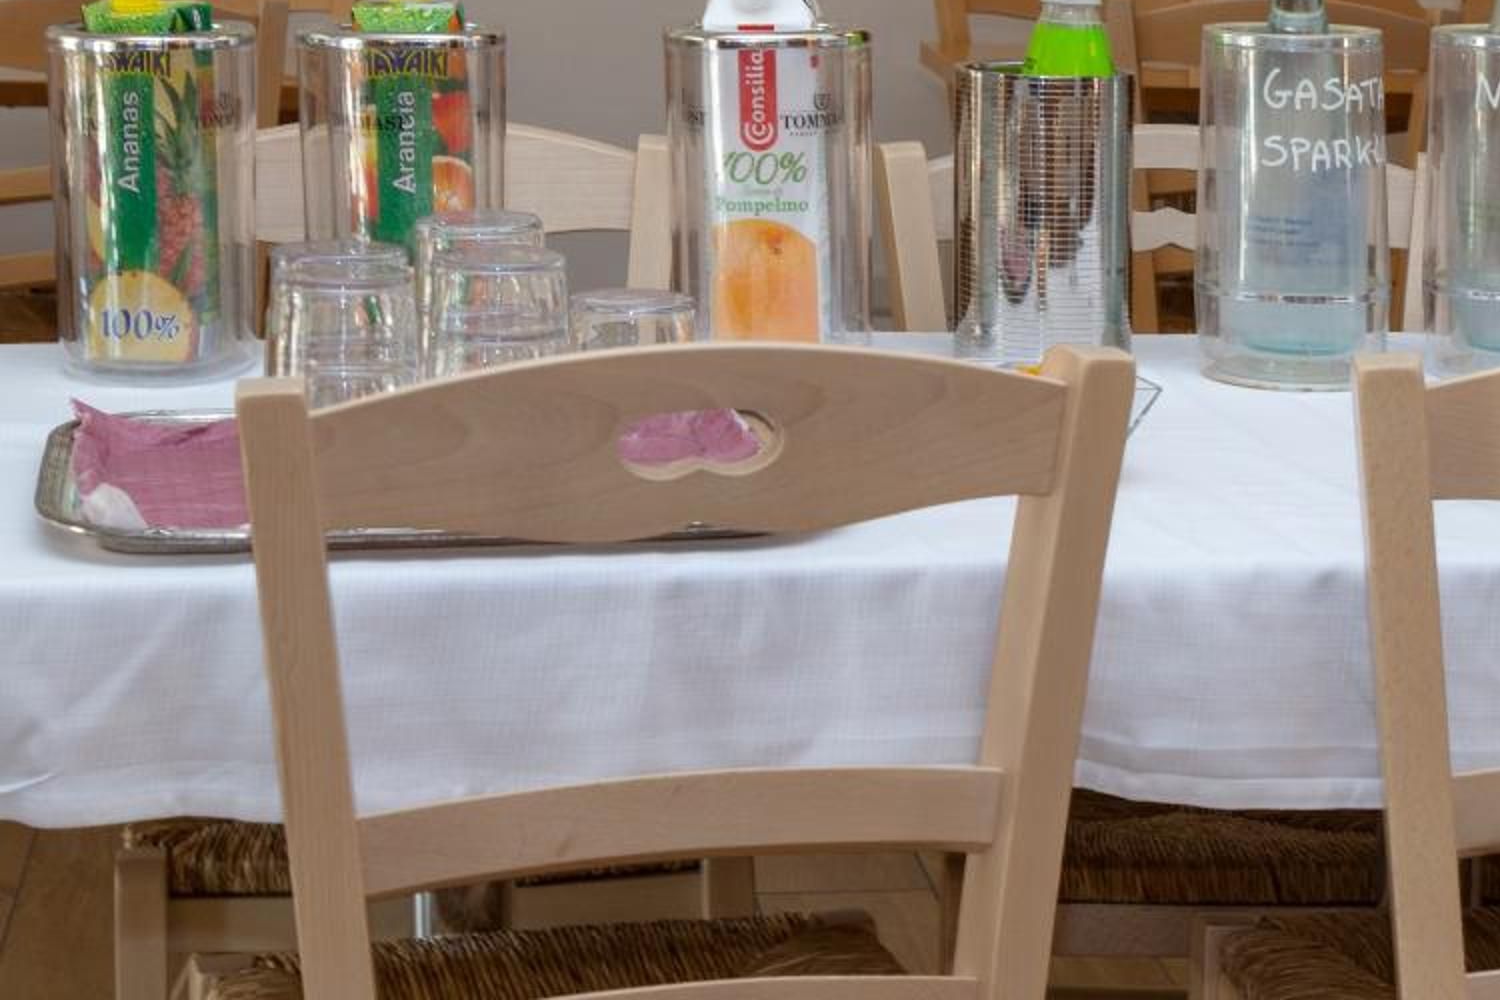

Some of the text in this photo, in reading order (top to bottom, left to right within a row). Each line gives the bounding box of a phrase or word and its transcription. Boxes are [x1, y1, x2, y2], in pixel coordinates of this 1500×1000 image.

[117, 91, 140, 194] Ananas
[392, 91, 416, 194] Arancia
[724, 151, 807, 184] 100%
[103, 309, 180, 339] 100%
